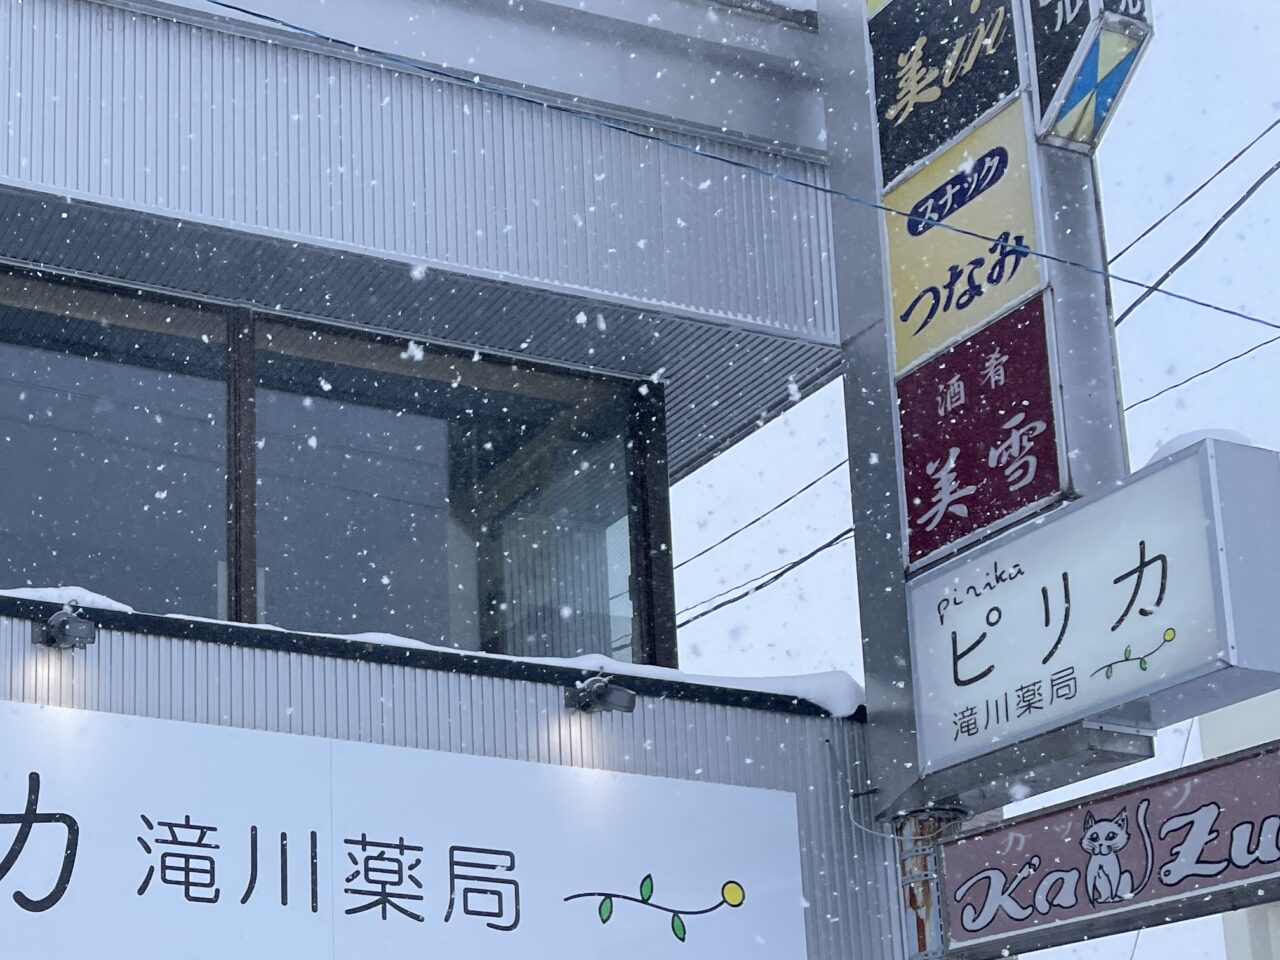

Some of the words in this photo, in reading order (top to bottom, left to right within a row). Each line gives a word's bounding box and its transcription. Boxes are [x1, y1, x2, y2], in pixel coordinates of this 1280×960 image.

[917, 154, 1000, 233] スナック
[899, 231, 1031, 337] つなみ
[936, 347, 1009, 418] 酒肴
[916, 412, 1048, 532] 美雪
[937, 561, 1025, 626] pirika
[951, 540, 1168, 687] ピリカ
[952, 666, 1078, 742] 滝川薬局
[136, 814, 521, 932] 滝川薬局
